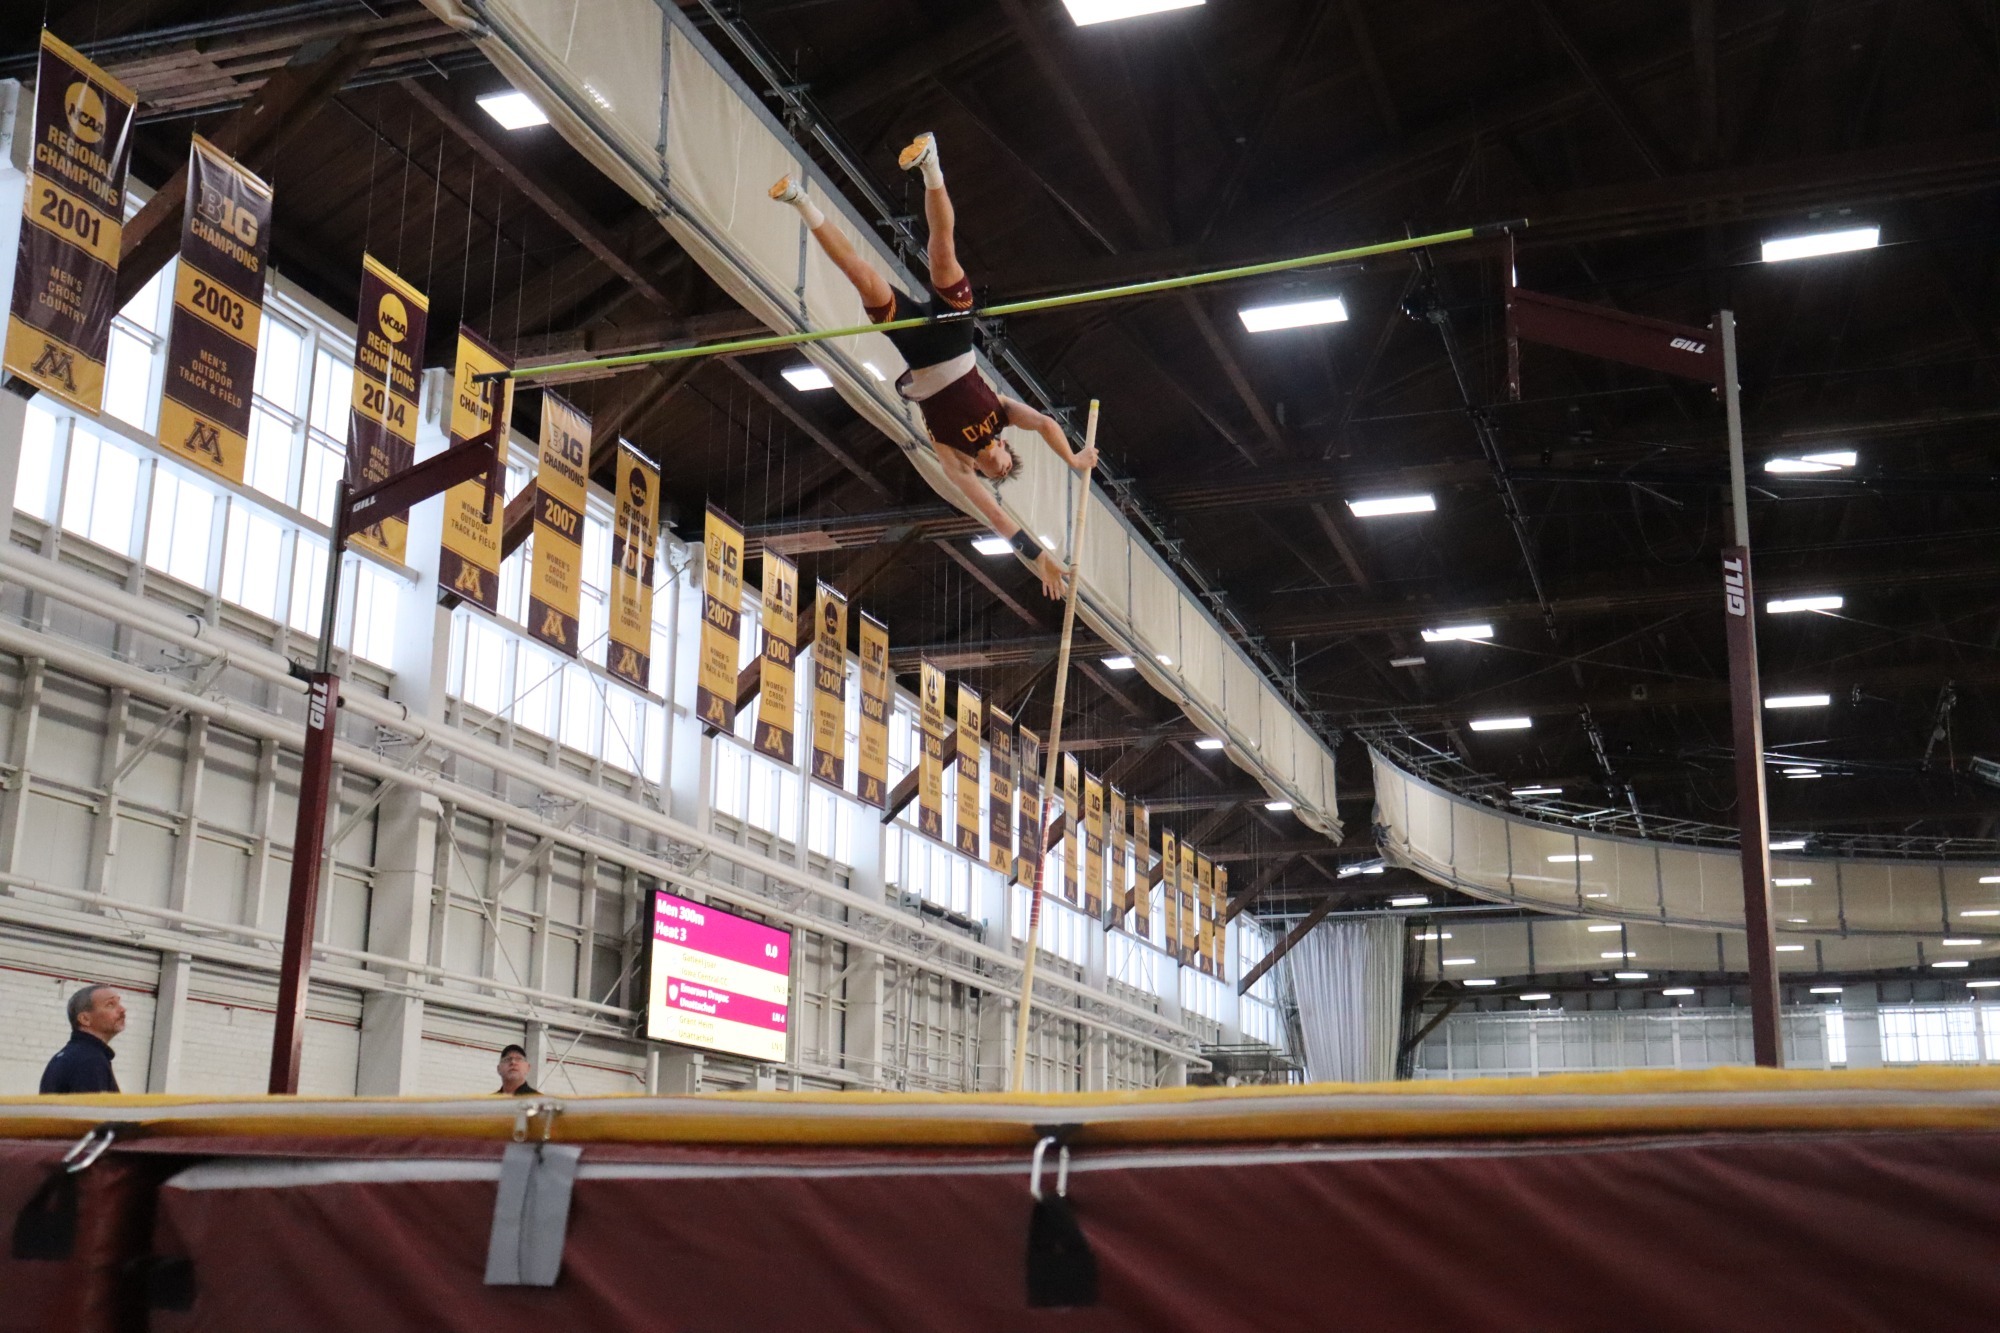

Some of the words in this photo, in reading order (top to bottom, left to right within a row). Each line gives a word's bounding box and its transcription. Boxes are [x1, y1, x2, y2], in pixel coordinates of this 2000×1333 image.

[69, 103, 104, 135] NCAA
[48, 125, 114, 181] REGIONAL
[37, 143, 118, 206] CHAMPIONS
[40, 189, 100, 247] 2001
[191, 217, 258, 273] CHAMPIONS
[51, 266, 82, 292] MEN'S
[48, 281, 81, 307] CROSS
[192, 279, 244, 330] 2003
[39, 292, 87, 325] COUNTRY
[381, 311, 407, 336] NCAA
[367, 331, 412, 372] REGIONAL
[1670, 338, 1706, 354] GILL
[200, 349, 227, 372] MEN'S
[179, 366, 207, 389] TRACK
[210, 384, 216, 395] &
[219, 388, 242, 409] FIELD
[192, 360, 233, 389] OUTDOOR
[369, 458, 389, 478] CROSS
[370, 446, 389, 465] MEN'S
[544, 452, 584, 488] CHAMPIONS
[353, 495, 376, 513] GILL
[544, 499, 577, 536] 2007
[451, 520, 470, 538] TRACK
[478, 535, 496, 551] FIELD
[460, 512, 488, 534] OUTDOOR
[546, 552, 570, 572] WOMEN'S
[549, 564, 566, 581] CROSS
[544, 574, 569, 593] COUNTRY
[1724, 557, 1745, 617] GILL
[709, 600, 733, 630] 2007
[818, 668, 841, 693] 2008
[309, 682, 328, 730] GILL
[864, 696, 882, 719] 2008
[656, 899, 678, 917] Men
[679, 906, 704, 926] 300m
[655, 921, 679, 940] Heat
[680, 928, 687, 941] 3
[765, 943, 778, 958] 0.0
